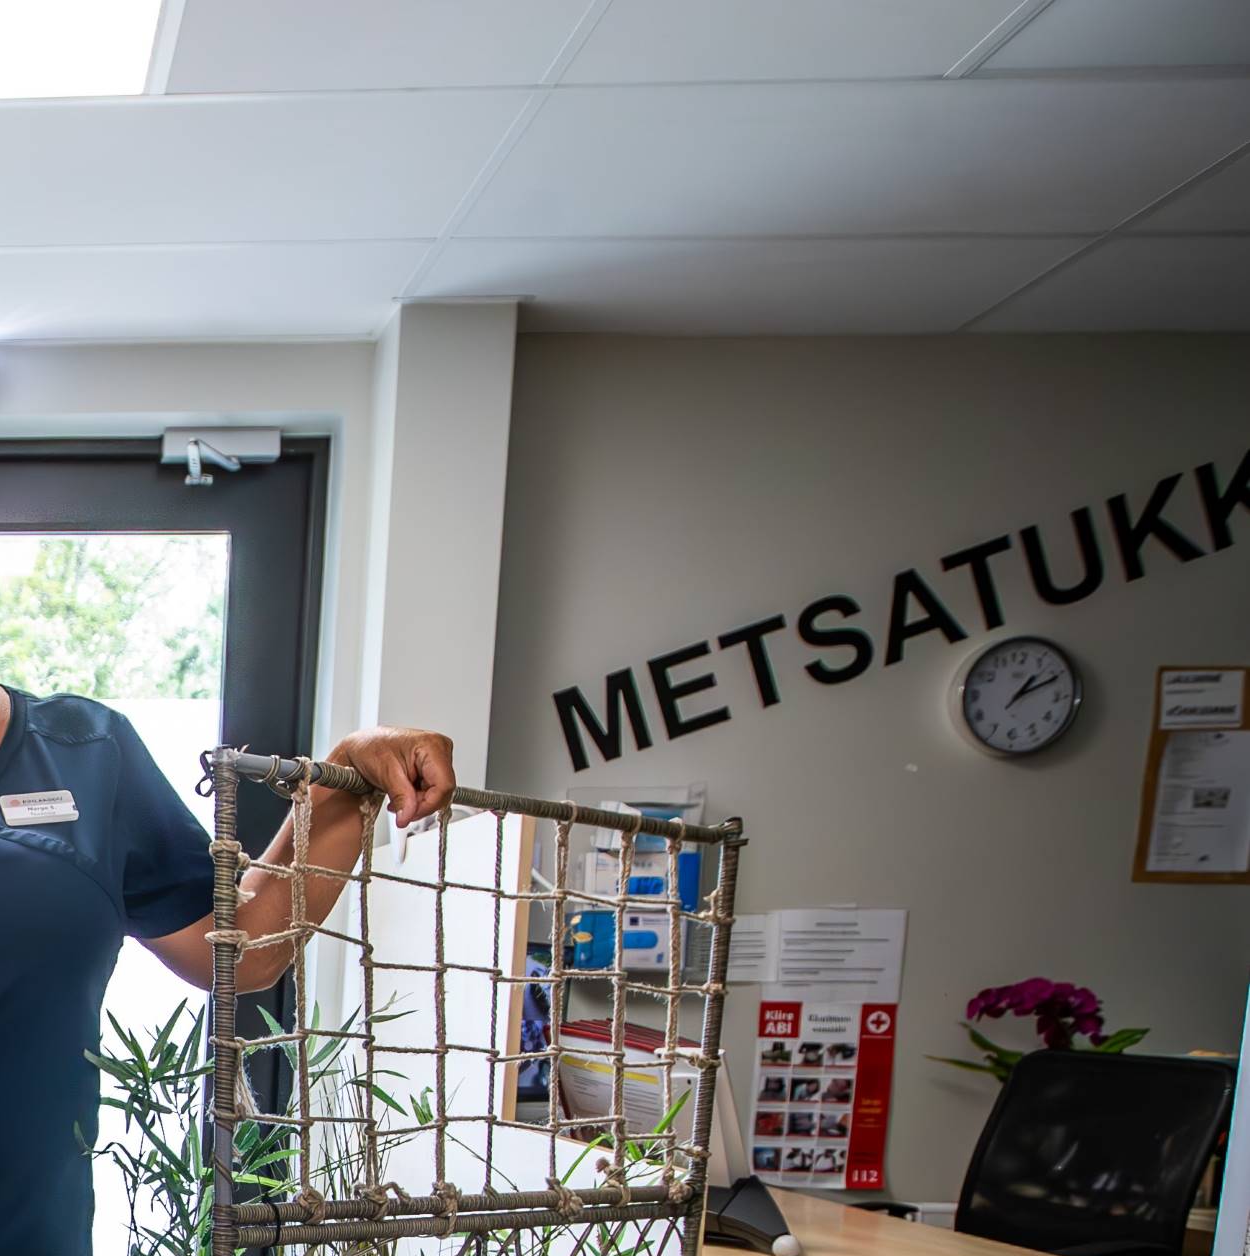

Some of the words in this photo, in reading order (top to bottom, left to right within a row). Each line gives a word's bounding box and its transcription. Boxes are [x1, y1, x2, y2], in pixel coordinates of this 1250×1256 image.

[552, 449, 1250, 772] METSATUKK
[764, 1021, 792, 1035] ABI
[851, 1169, 879, 1183] 112
